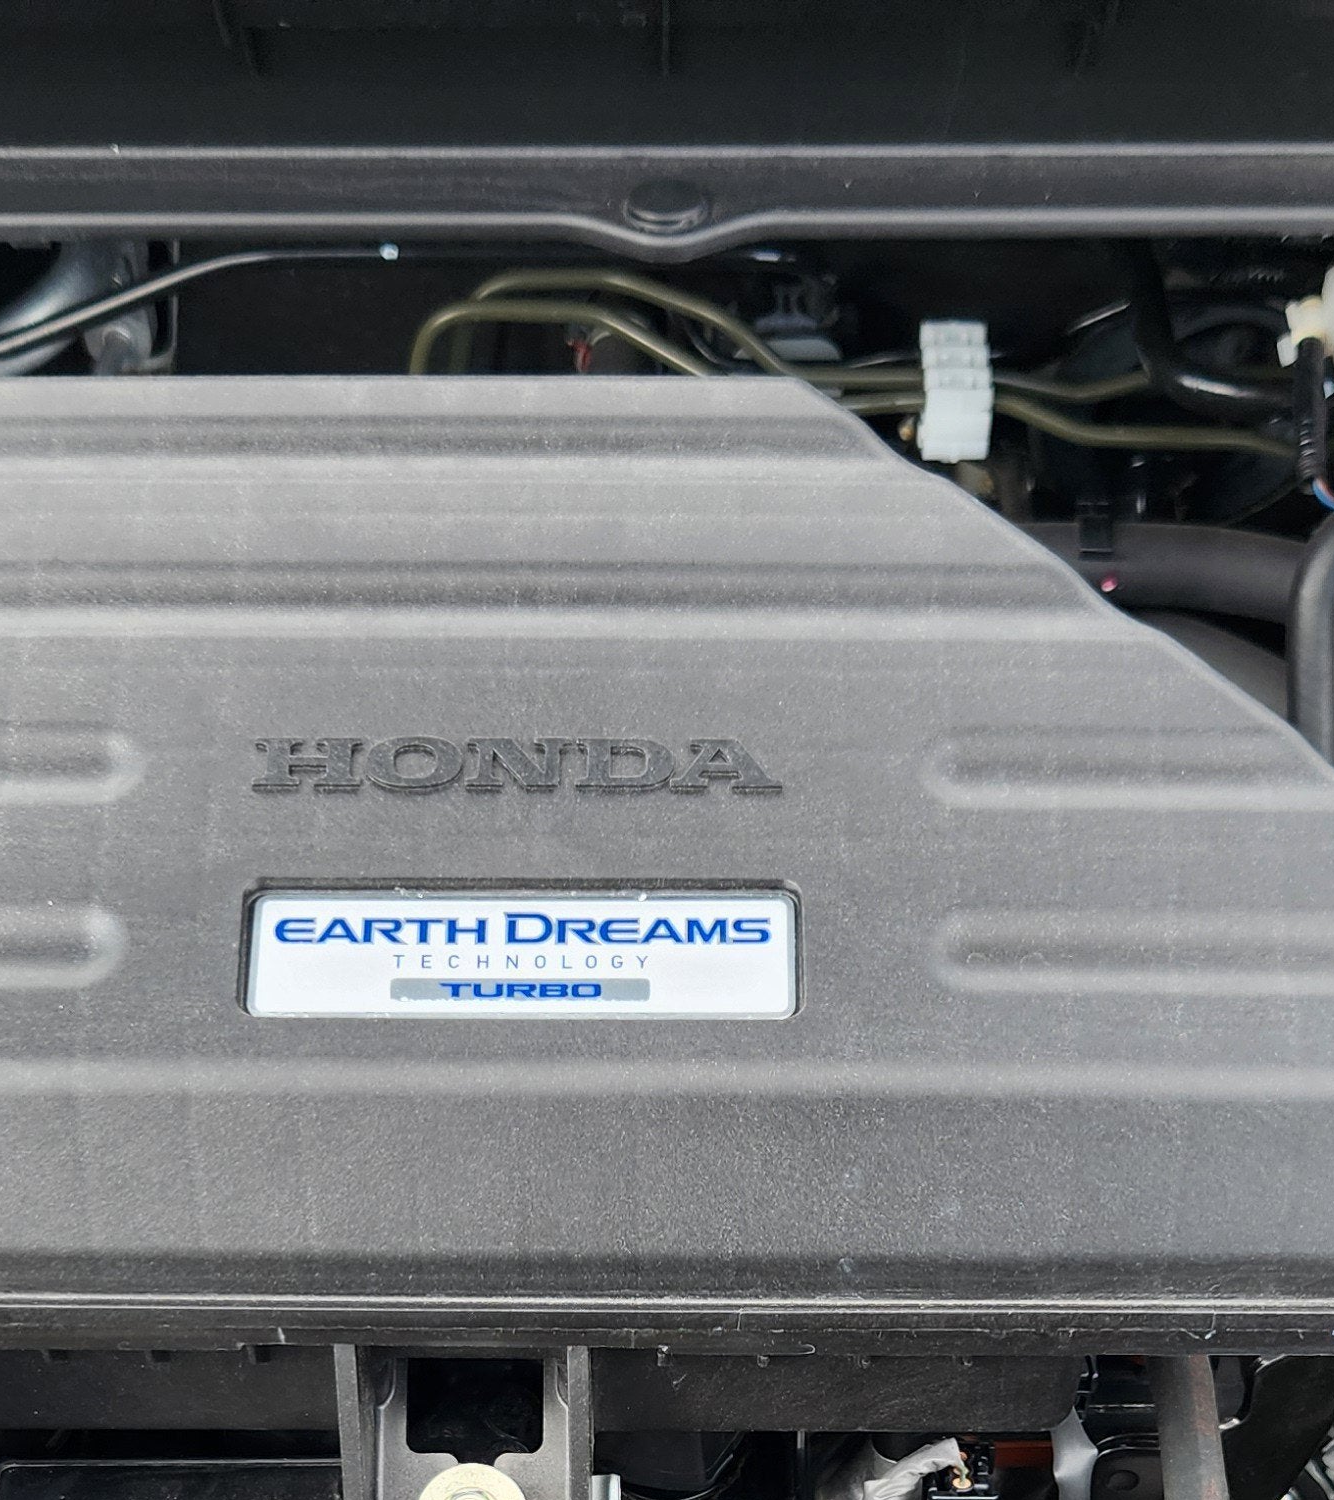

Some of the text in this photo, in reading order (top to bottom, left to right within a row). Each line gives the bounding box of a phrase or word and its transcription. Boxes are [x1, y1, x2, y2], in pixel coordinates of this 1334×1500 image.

[252, 736, 784, 795] HONDA
[274, 911, 771, 946] EARTH DREAMS
[392, 954, 651, 970] TECHNOLOGY
[439, 982, 603, 999] TURBO
